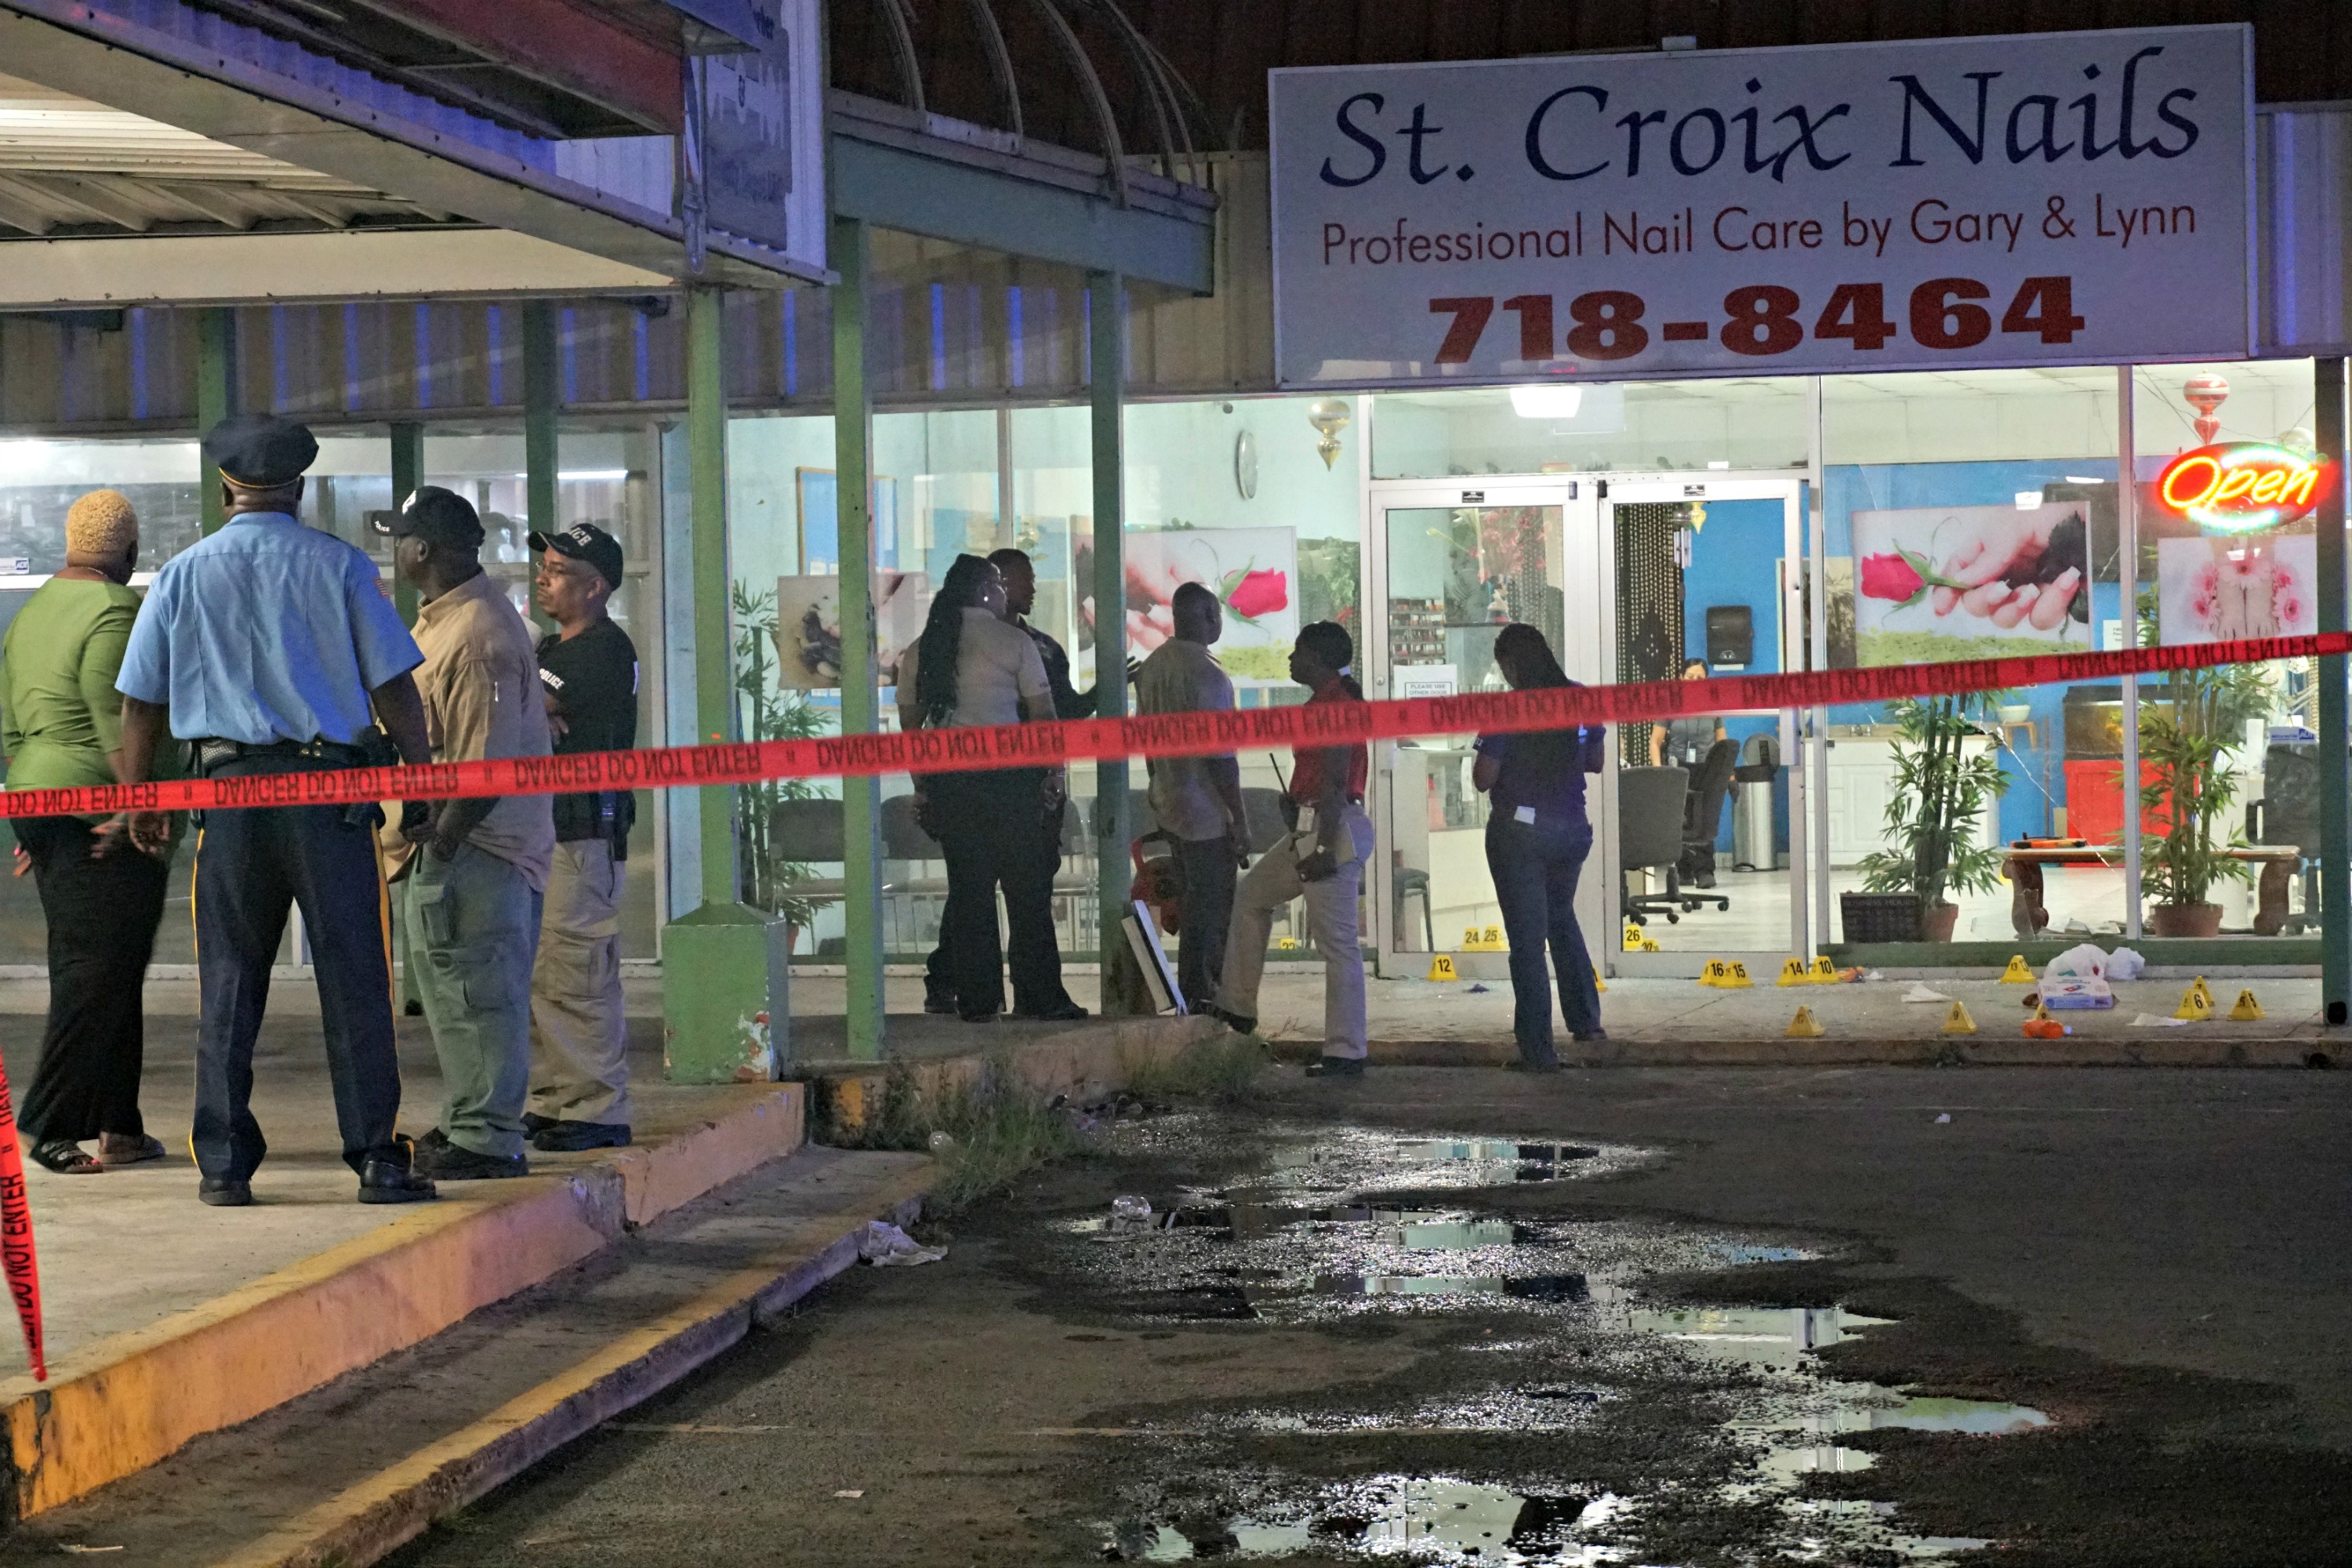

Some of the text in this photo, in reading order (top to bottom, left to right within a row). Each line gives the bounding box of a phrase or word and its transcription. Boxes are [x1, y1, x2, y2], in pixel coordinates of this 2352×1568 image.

[1319, 45, 2199, 187] St. Croix Nails
[1323, 192, 2195, 265] Professional Nail Care by Gary & Lynn
[1429, 276, 2085, 364] 718-8464
[2163, 456, 2318, 510] Open
[539, 668, 564, 690] POLICE
[1465, 931, 1479, 944] 24
[1484, 930, 1497, 942] 25
[1626, 929, 1640, 942] 26
[1437, 959, 1451, 972] 12
[1711, 963, 1724, 977] 16
[1733, 964, 1745, 978] 15
[1789, 961, 1803, 975] 14
[1819, 960, 1832, 974] 10
[2010, 963, 2018, 971] 13
[2194, 993, 2203, 1009] 6
[1952, 1010, 1959, 1020] 9
[2, 1174, 28, 1236] ENTER
[3, 1243, 31, 1276] NOT
